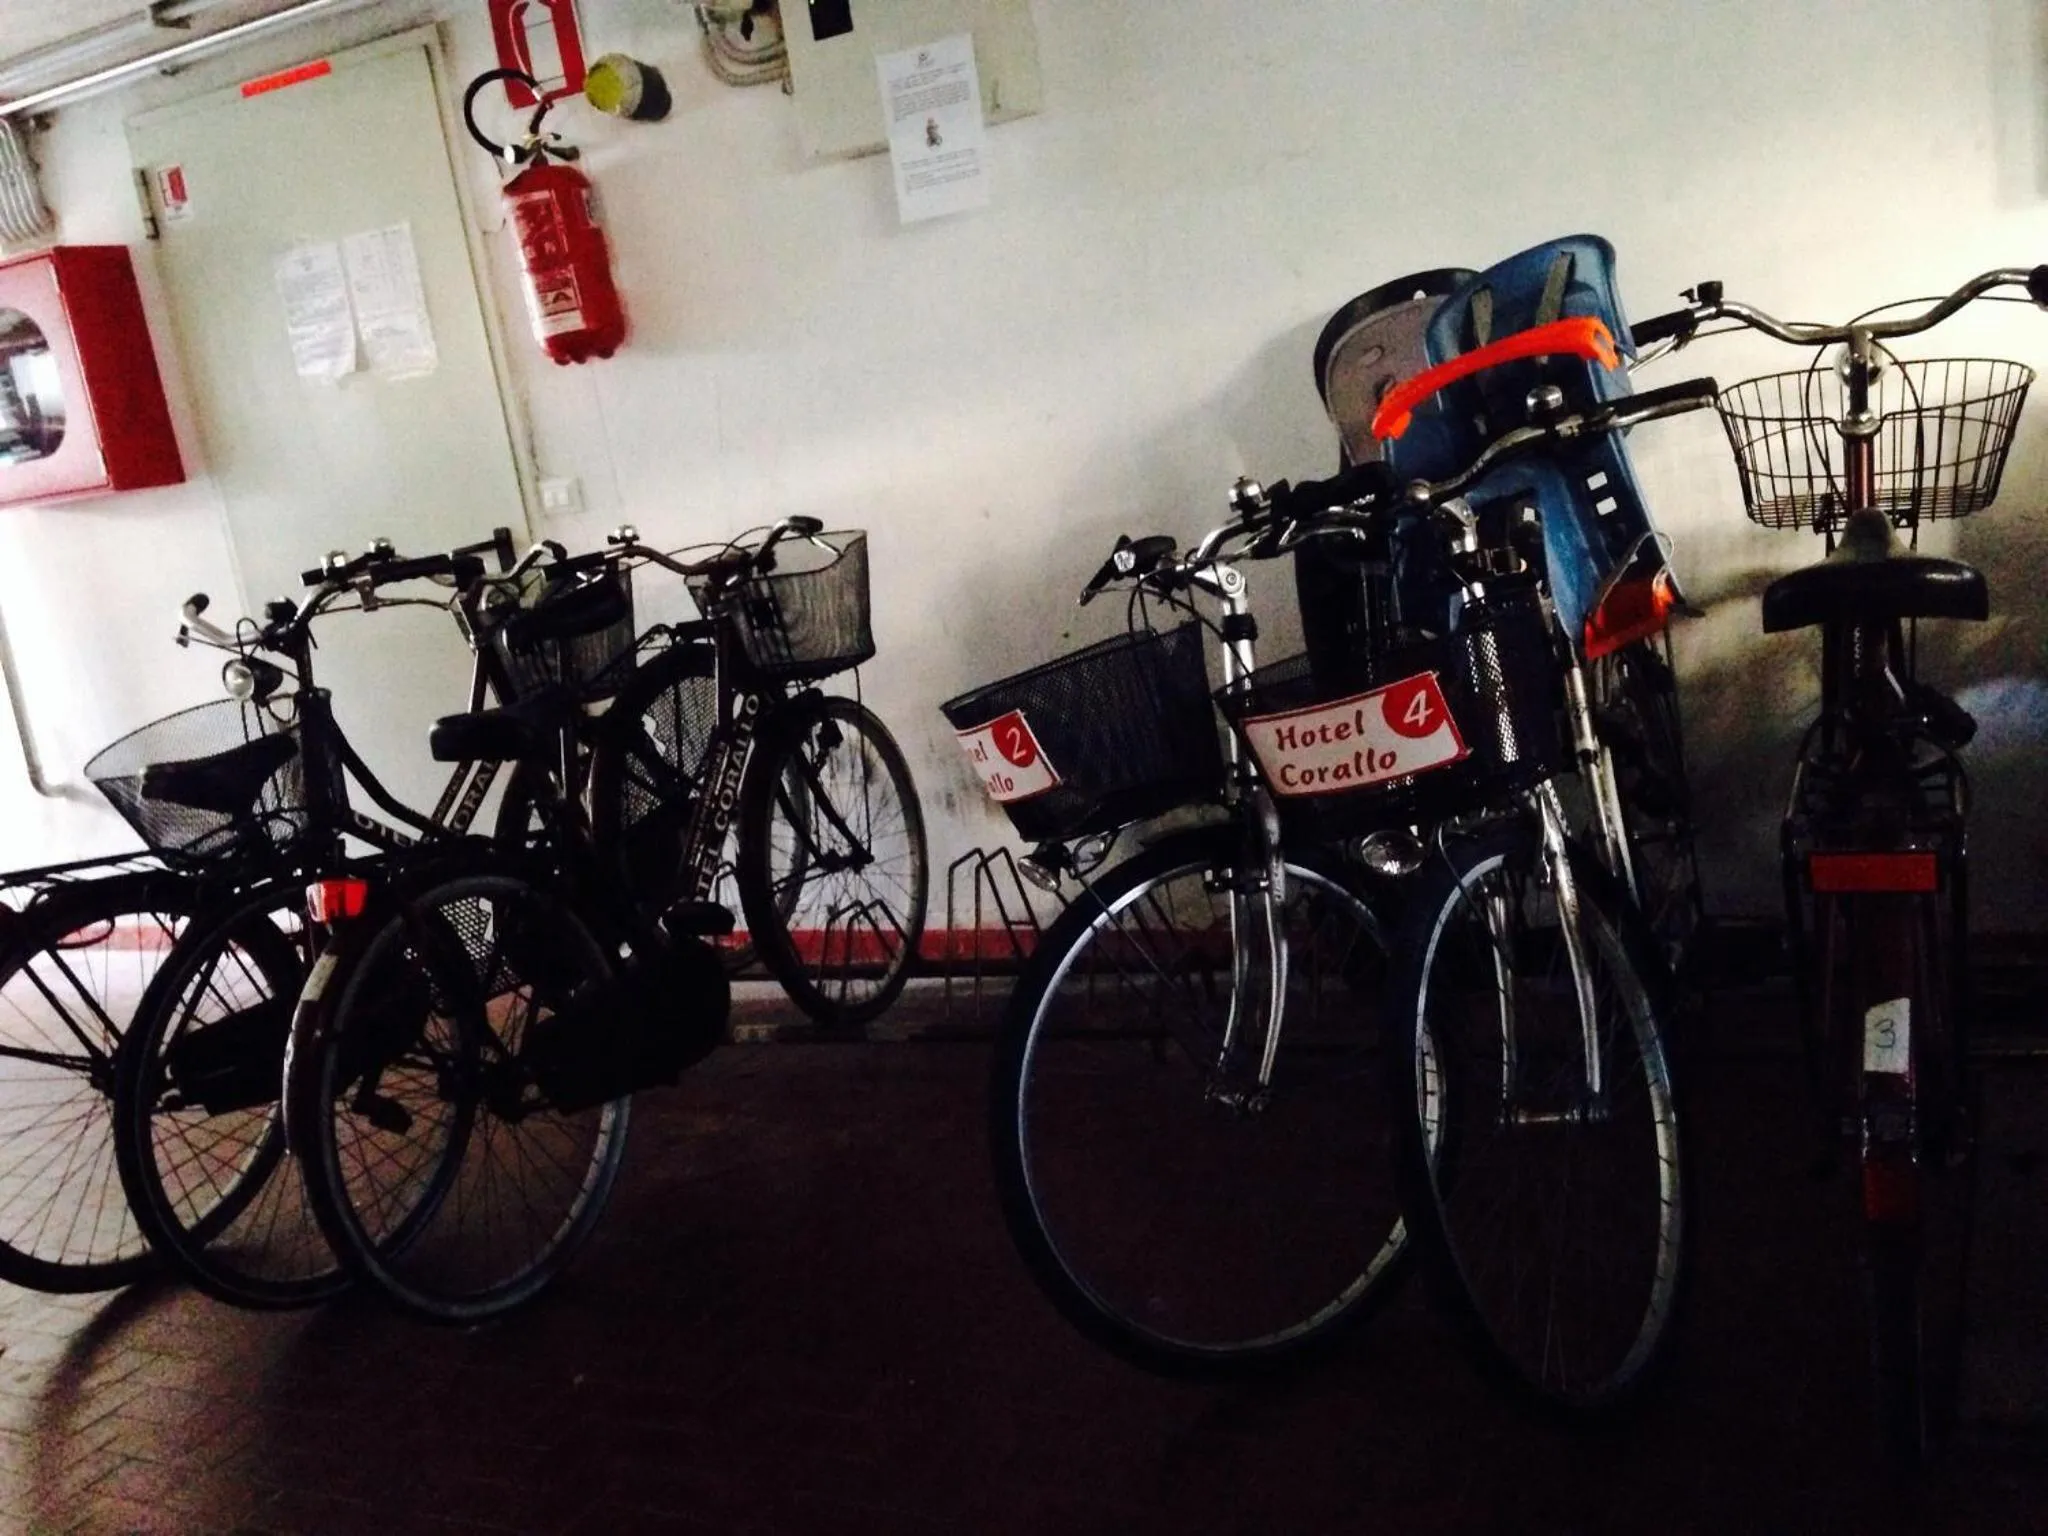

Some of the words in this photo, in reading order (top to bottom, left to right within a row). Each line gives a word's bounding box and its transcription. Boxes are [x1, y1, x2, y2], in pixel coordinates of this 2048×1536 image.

[1403, 689, 1434, 728] 4
[1005, 726, 1027, 761] 2
[1275, 709, 1365, 751] Hotel
[1280, 747, 1397, 786] Corallo
[694, 845, 722, 902] TEL
[714, 693, 760, 832] CORALLO
[1874, 1018, 1896, 1048] 3
